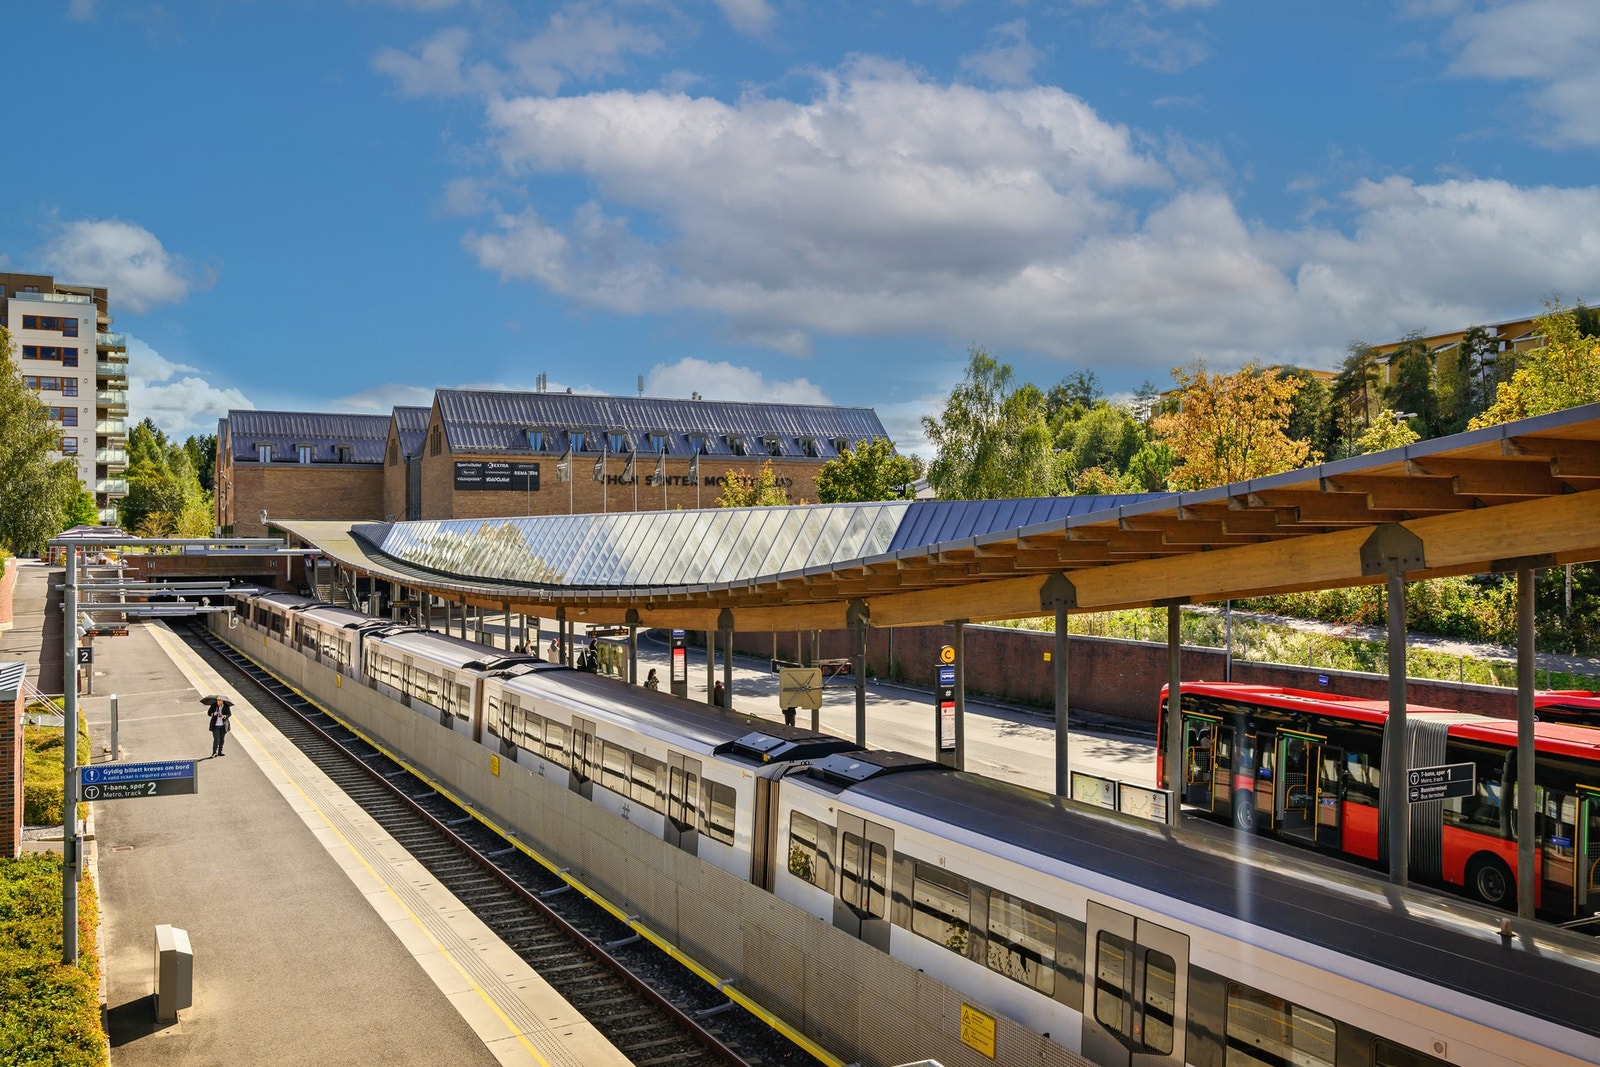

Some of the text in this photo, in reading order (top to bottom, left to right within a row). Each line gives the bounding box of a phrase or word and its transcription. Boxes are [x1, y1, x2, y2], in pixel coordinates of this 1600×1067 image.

[81, 651, 89, 662] 2
[944, 650, 952, 660] C
[1446, 769, 1451, 780] 1
[147, 781, 157, 795] 2
